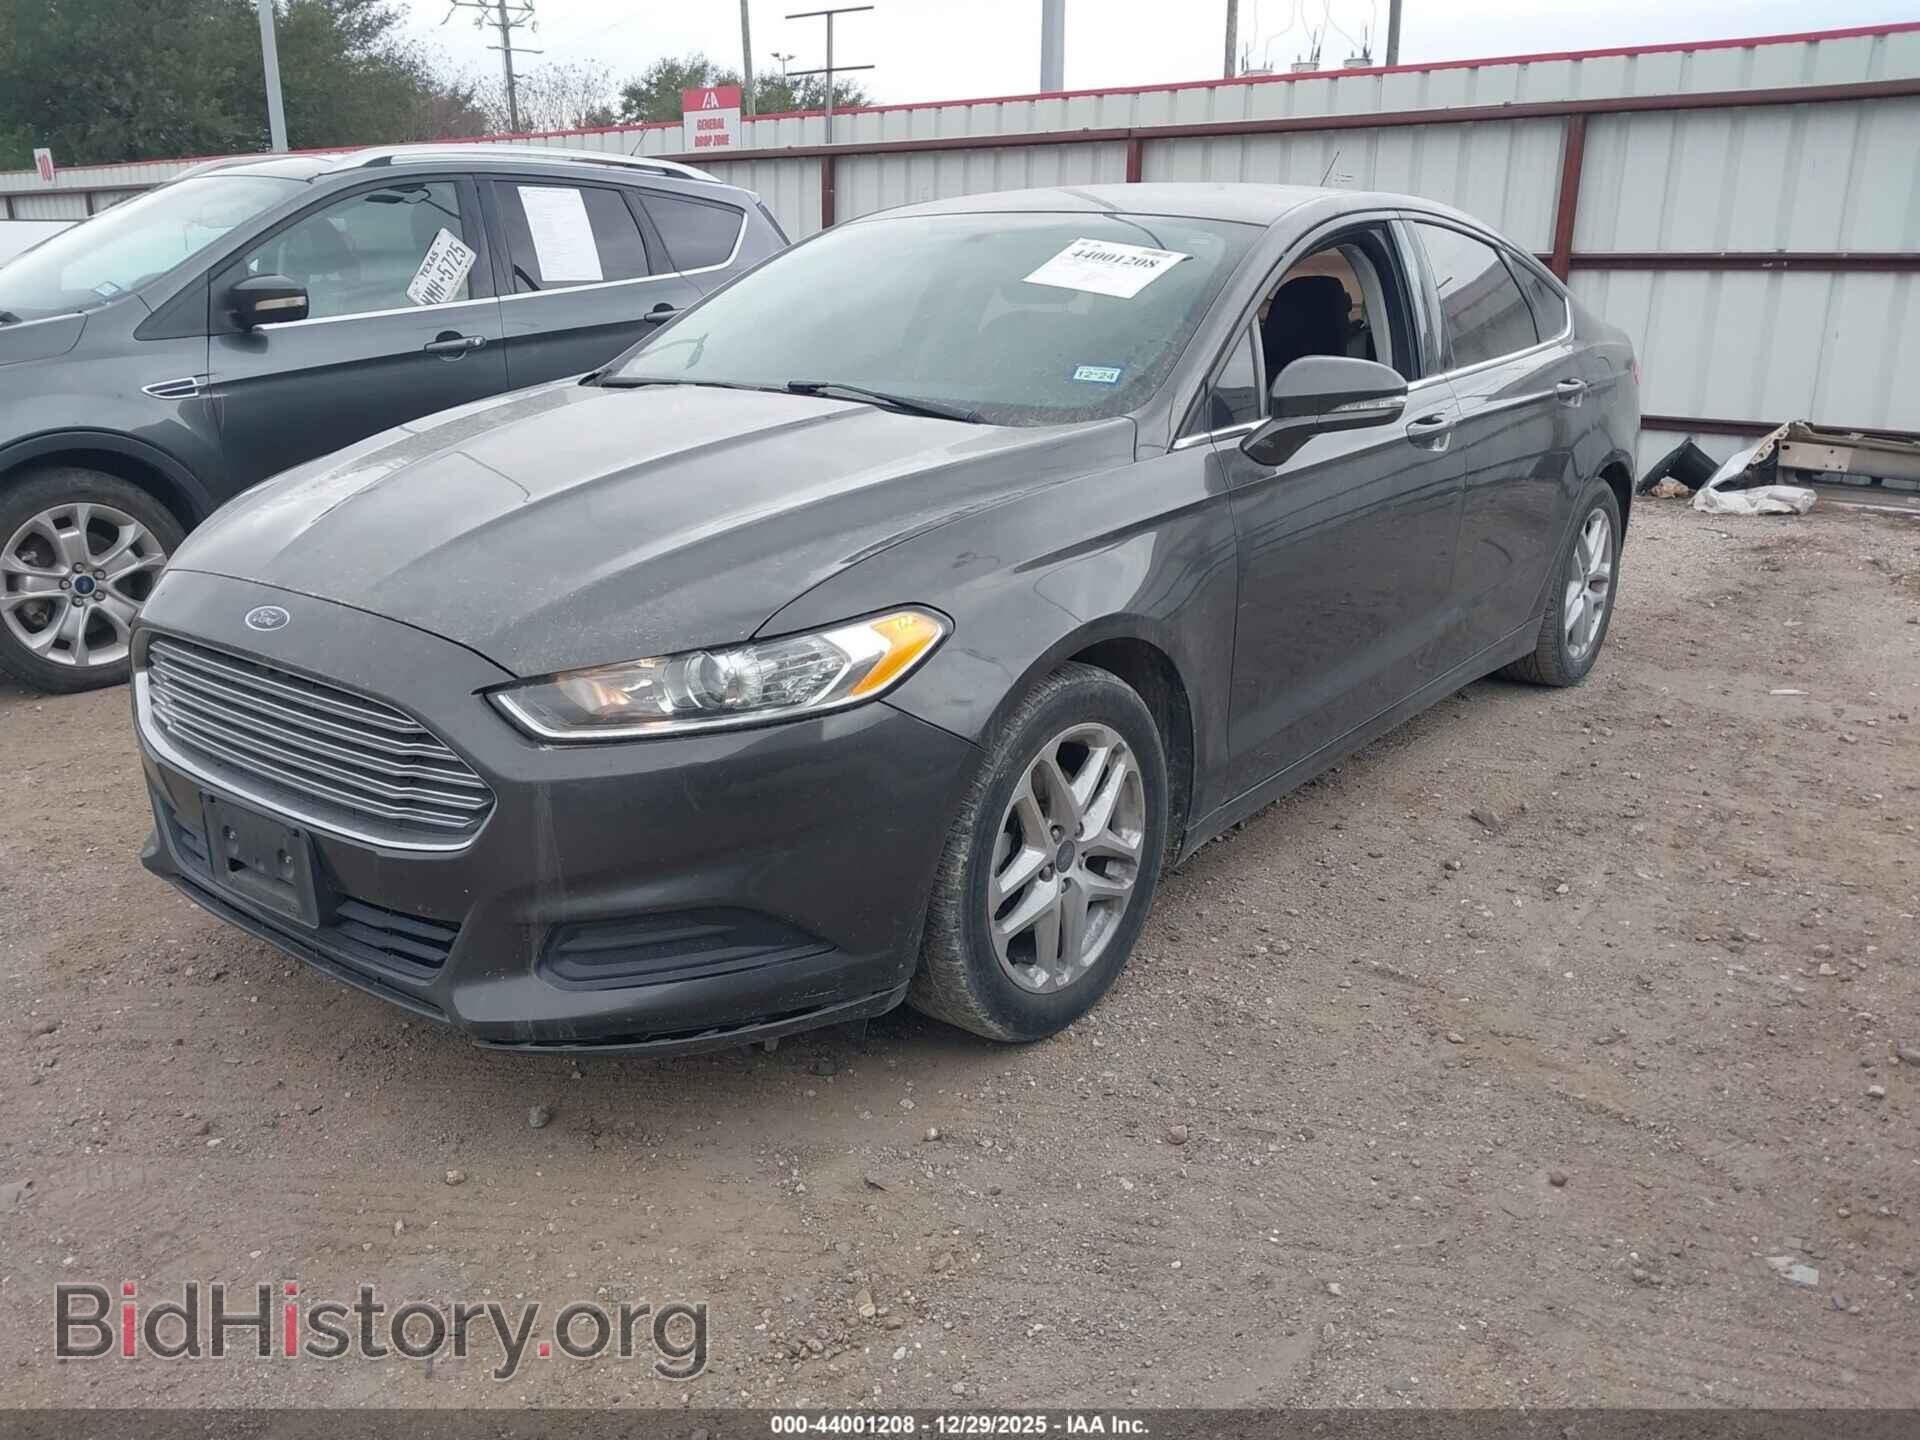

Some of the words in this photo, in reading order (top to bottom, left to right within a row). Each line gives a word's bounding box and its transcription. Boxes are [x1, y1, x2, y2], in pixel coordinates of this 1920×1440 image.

[696, 118, 725, 130] GENERAL
[713, 134, 730, 146] ZONE
[420, 249, 439, 278] TEXAS
[1071, 249, 1160, 269] 44001208
